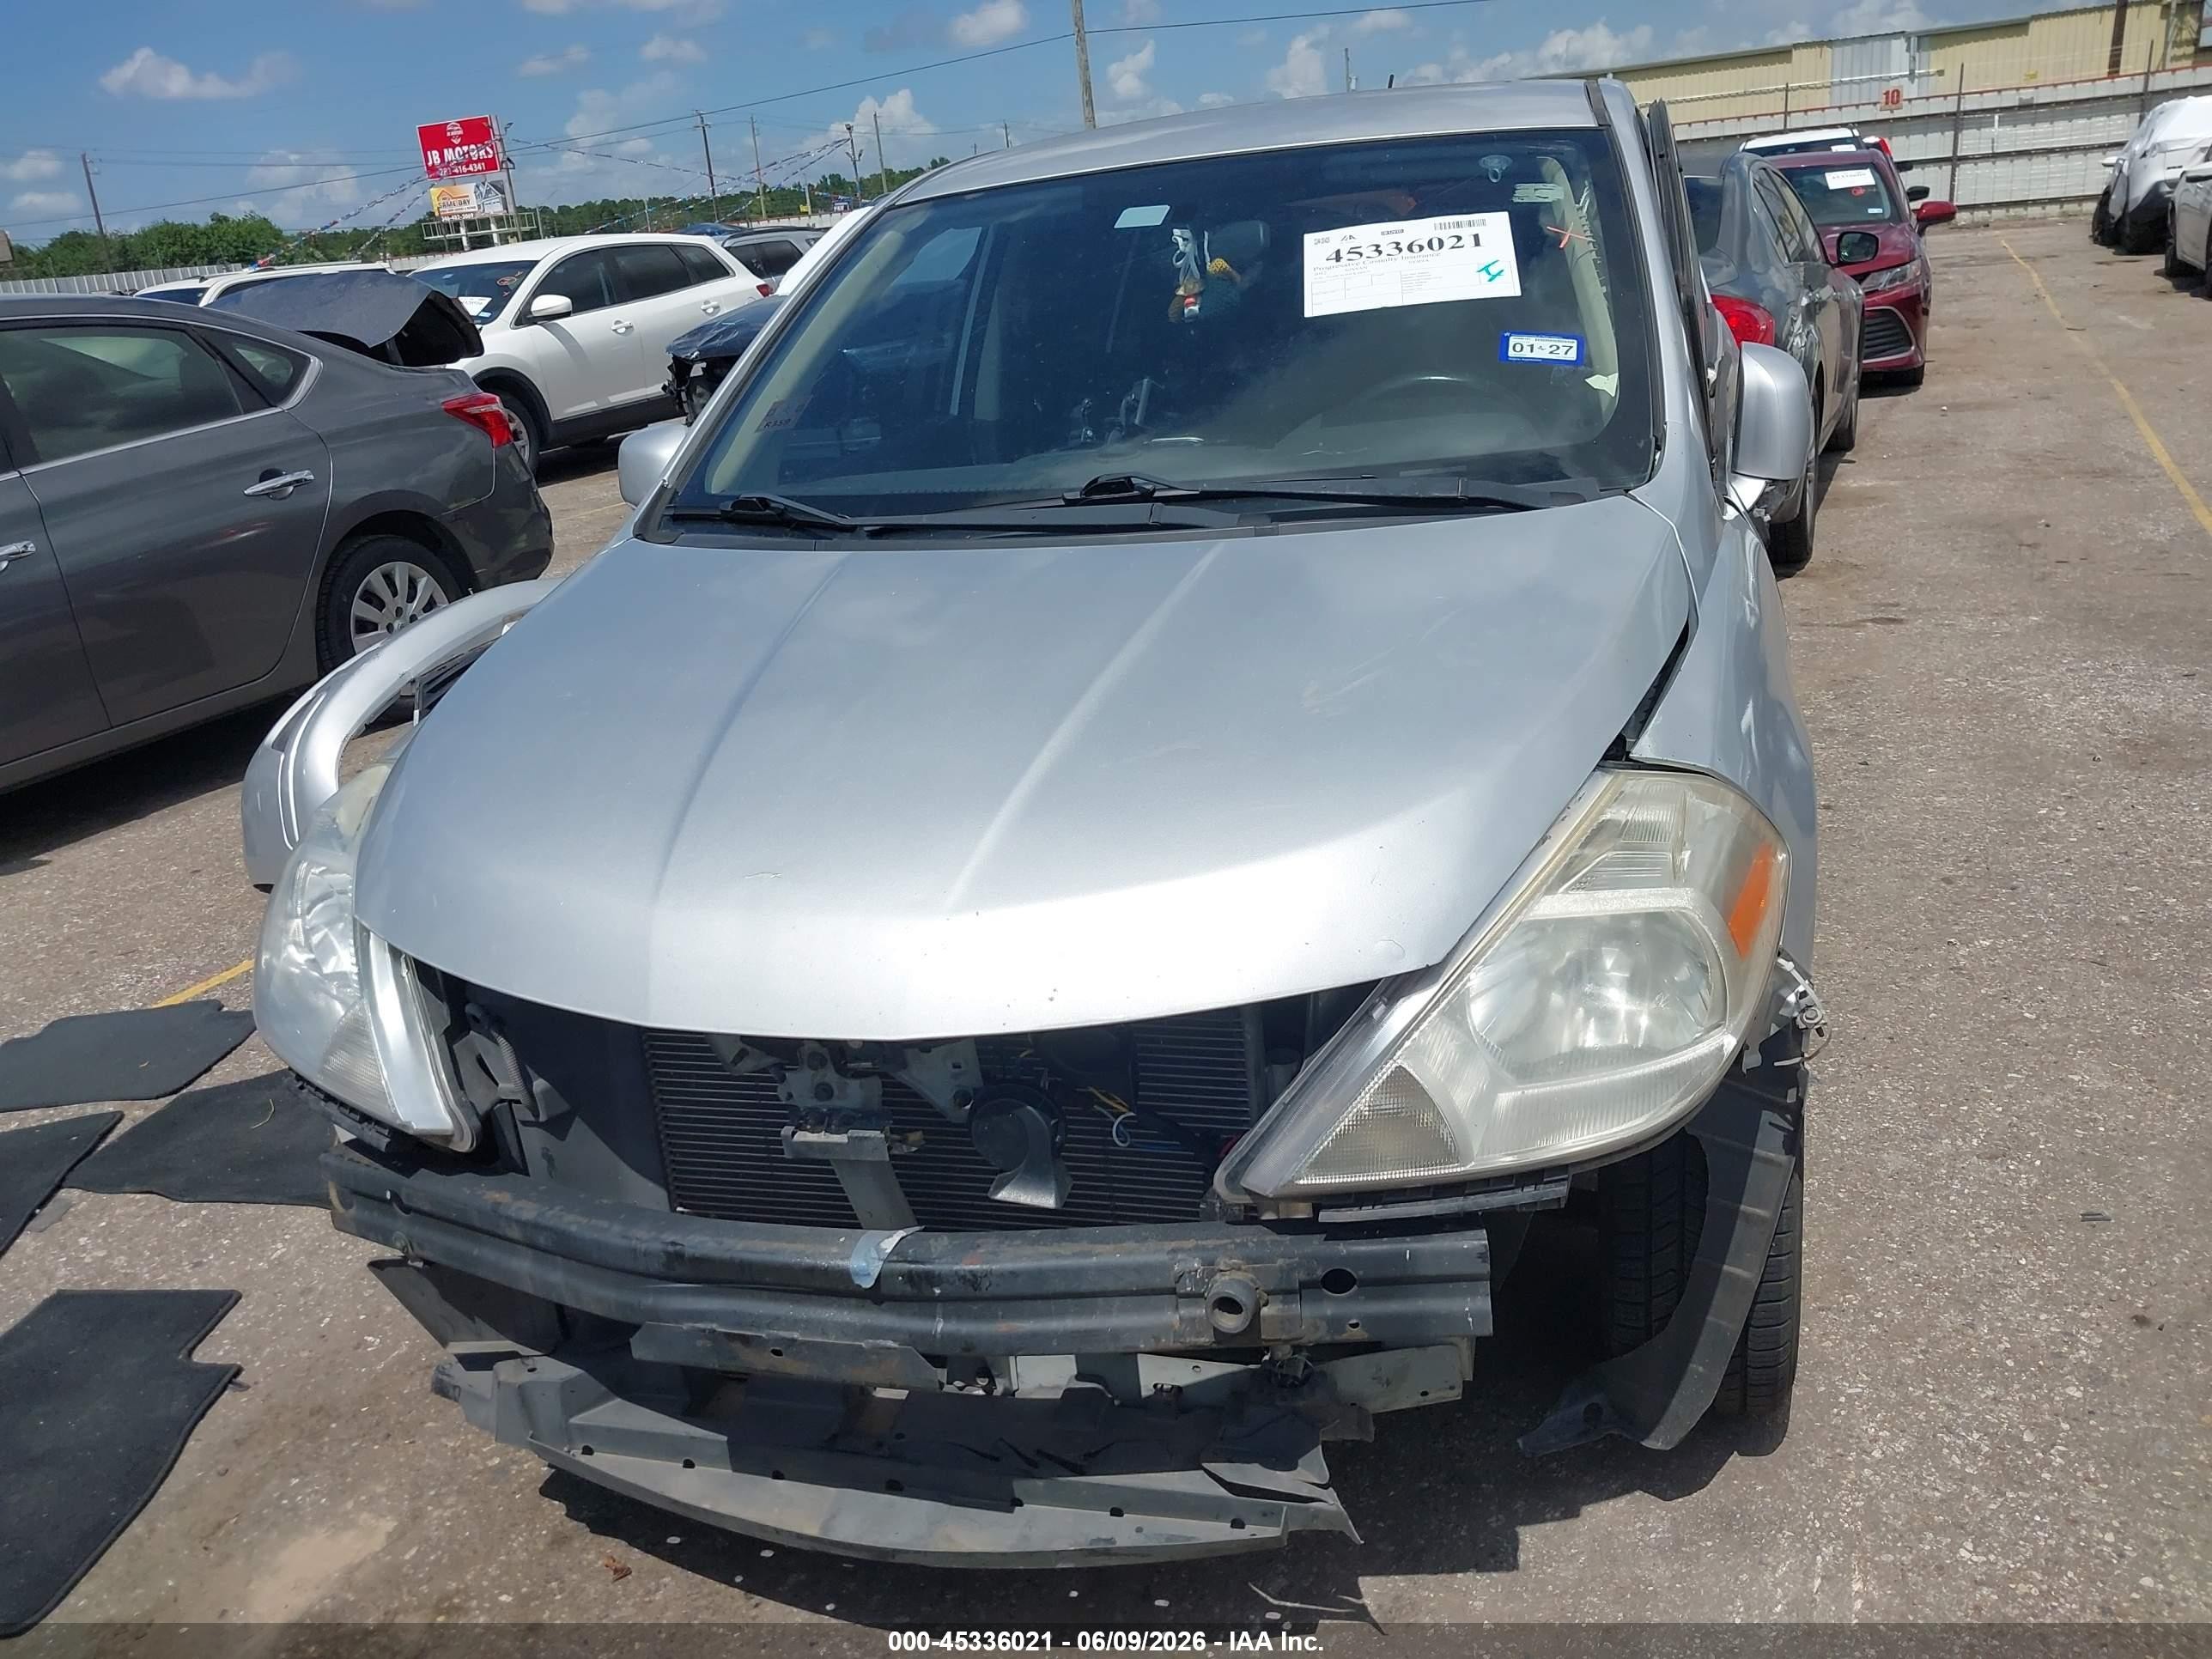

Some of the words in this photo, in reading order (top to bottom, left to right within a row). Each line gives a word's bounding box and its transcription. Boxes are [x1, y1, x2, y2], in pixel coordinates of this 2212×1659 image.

[1883, 88, 1900, 106] 10
[427, 149, 441, 167] JB
[443, 143, 494, 162] MOTORS
[1325, 233, 1485, 263] 45336021
[1313, 261, 1360, 271] Progressive
[1401, 252, 1441, 261] Insurance
